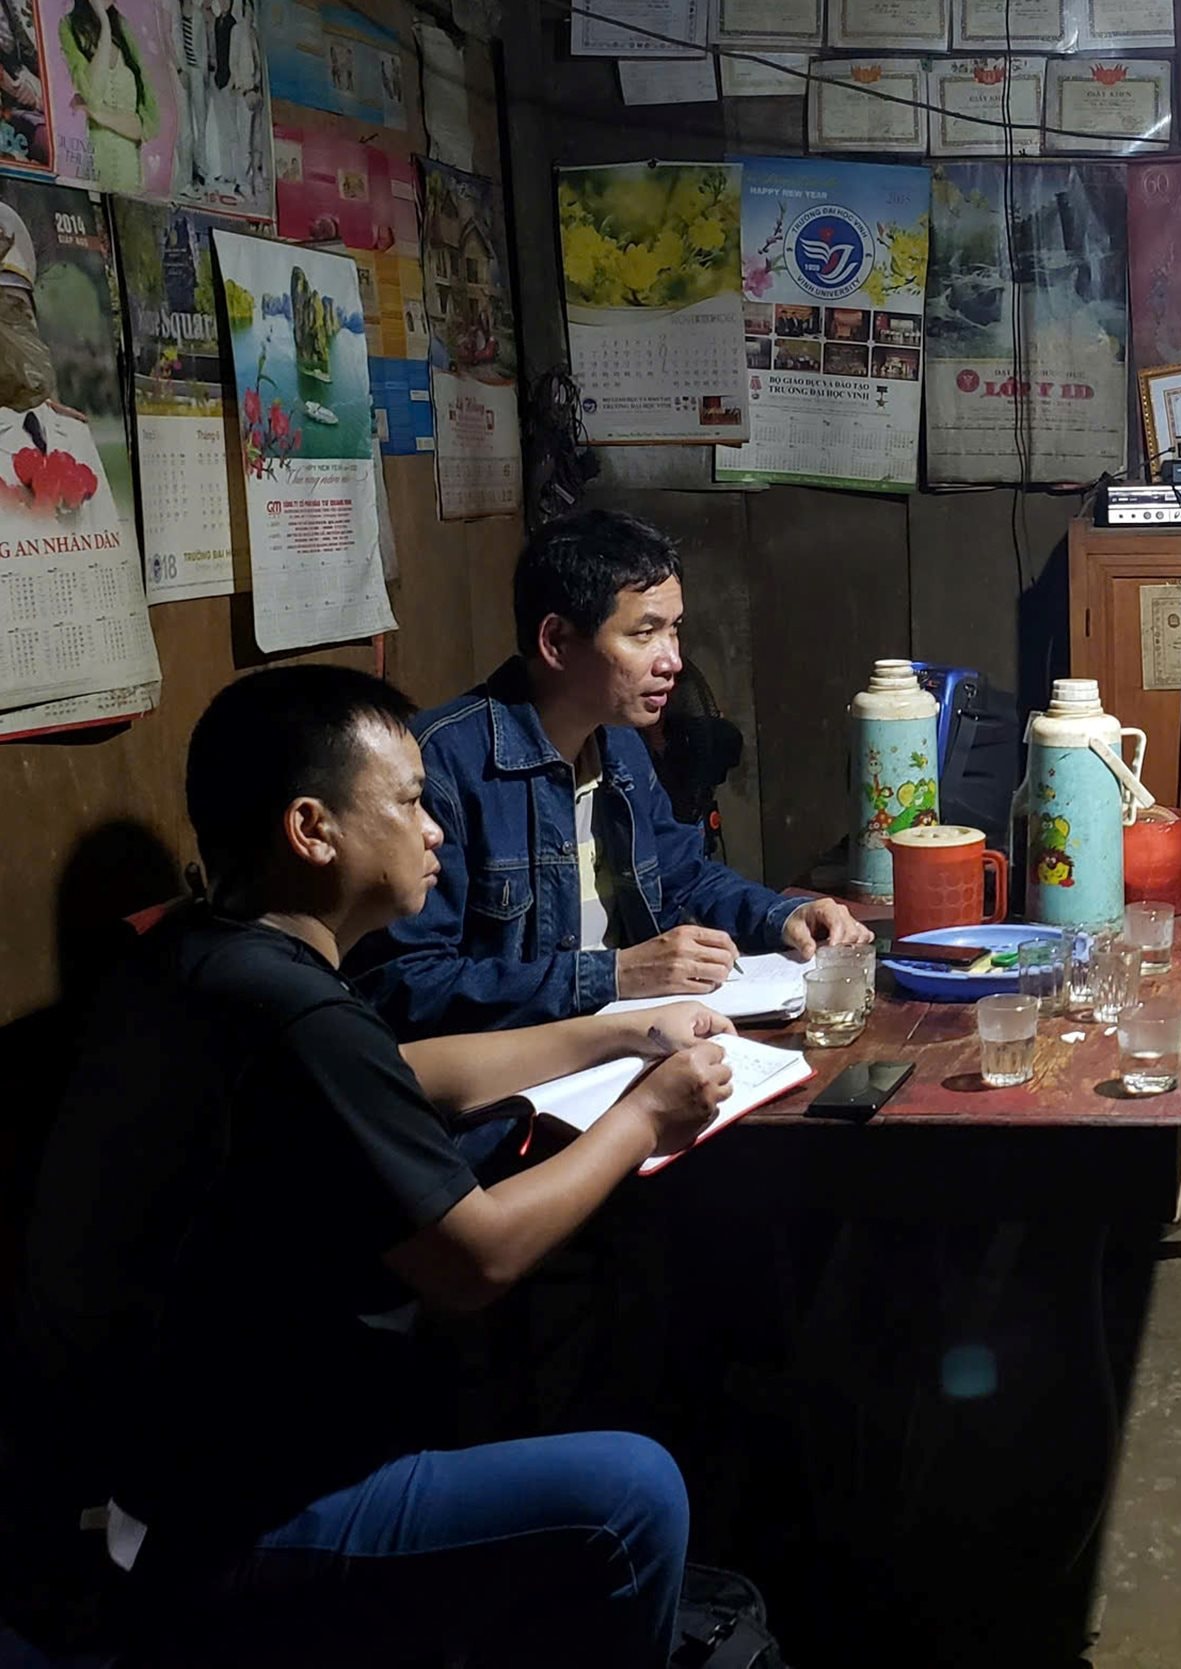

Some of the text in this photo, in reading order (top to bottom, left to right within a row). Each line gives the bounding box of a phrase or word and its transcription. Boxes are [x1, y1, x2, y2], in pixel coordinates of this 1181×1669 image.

[750, 186, 828, 200] HAPPY NEW YEAR
[55, 212, 86, 235] 2014
[792, 208, 822, 234] TRƯỜNG
[854, 219, 869, 239] VINH
[797, 275, 861, 298] VINH UNIVERSITY
[769, 376, 782, 385] BỘ
[782, 375, 804, 385] GIÁO
[769, 385, 870, 401] TRƯỜNG ĐẠI HỌC VINH
[15, 539, 41, 557] AN
[43, 532, 92, 554] NHÂN
[94, 529, 121, 550] DÂN
